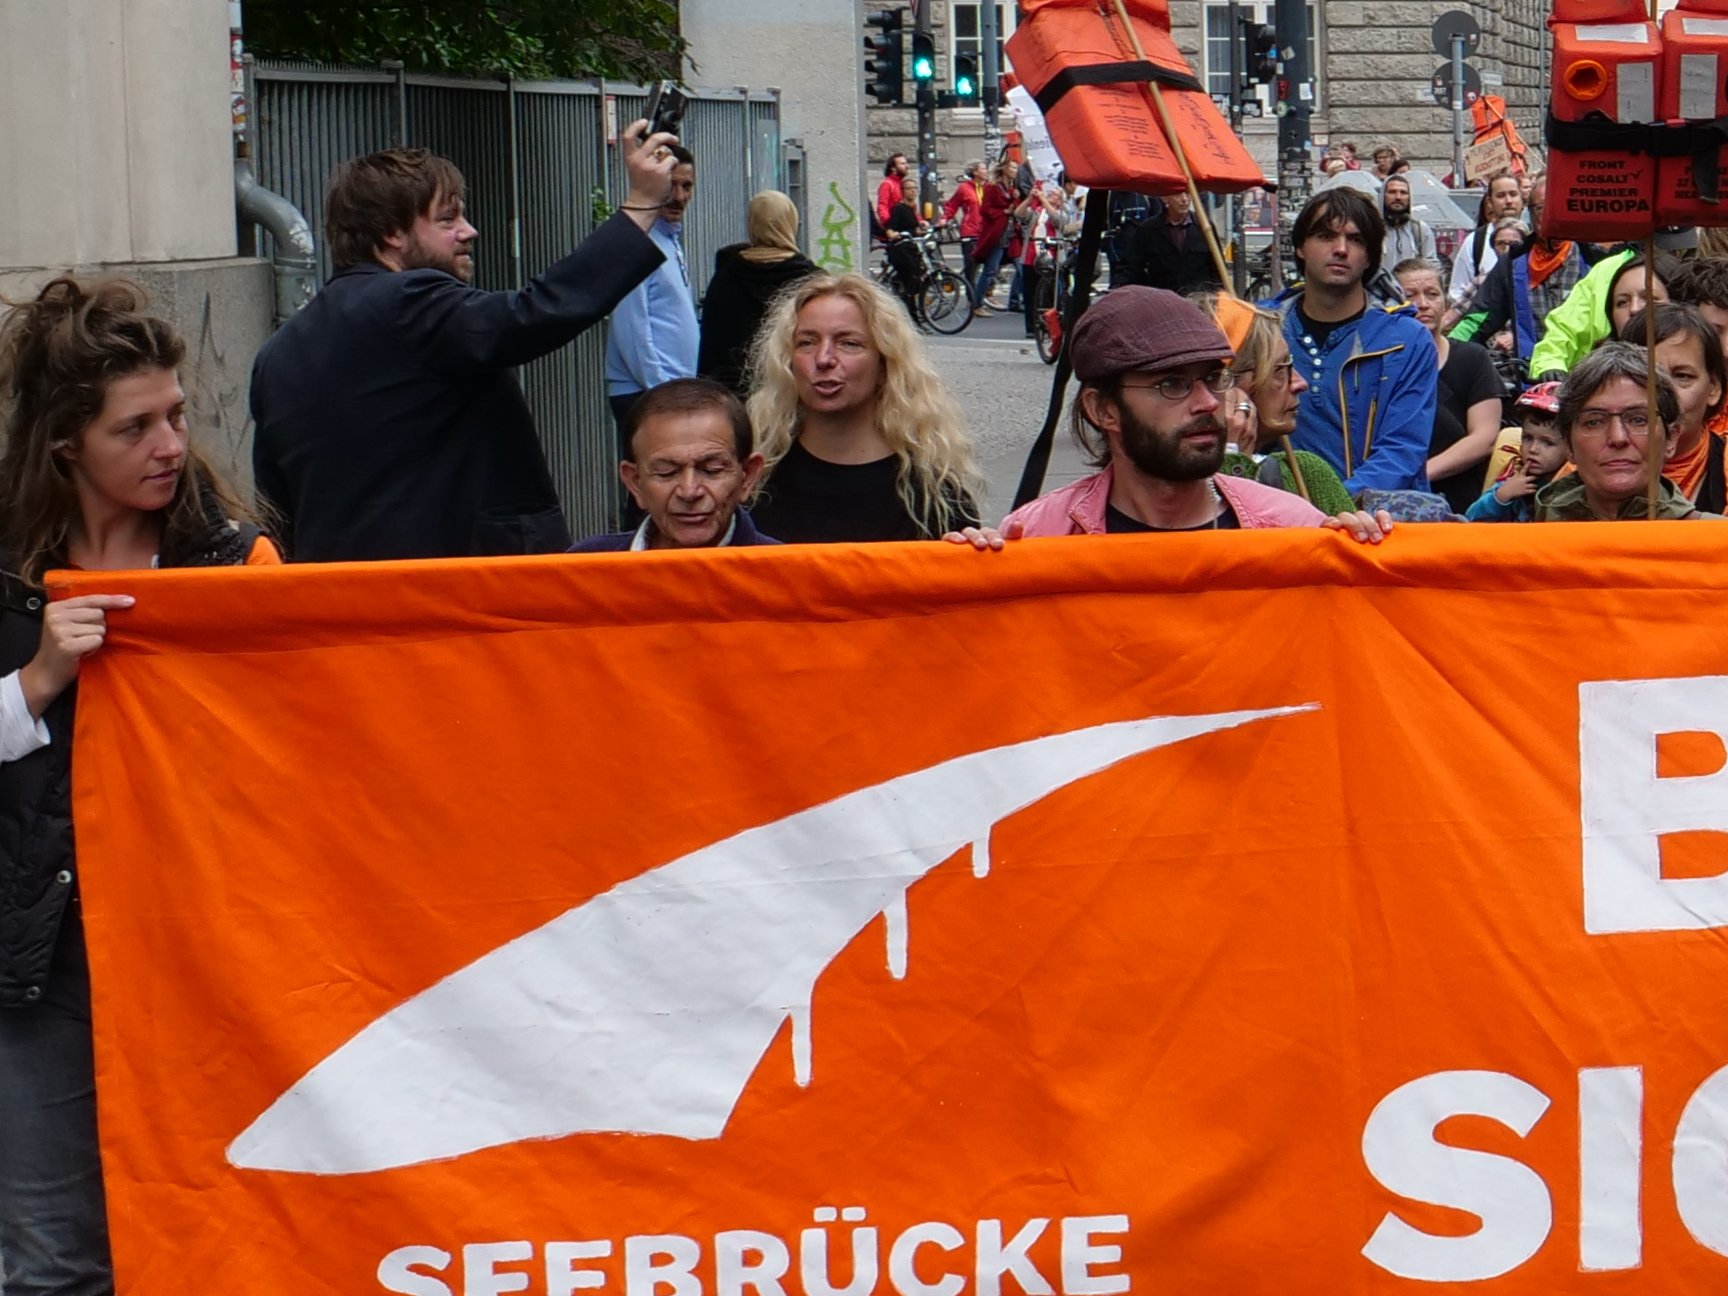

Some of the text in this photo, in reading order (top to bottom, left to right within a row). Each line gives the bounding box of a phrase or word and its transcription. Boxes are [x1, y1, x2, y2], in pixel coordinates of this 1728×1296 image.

[1579, 160, 1626, 170] FRONT
[1576, 174, 1629, 184] COSALT
[1569, 187, 1639, 198] PREMIER
[1566, 199, 1650, 213] EUROPA
